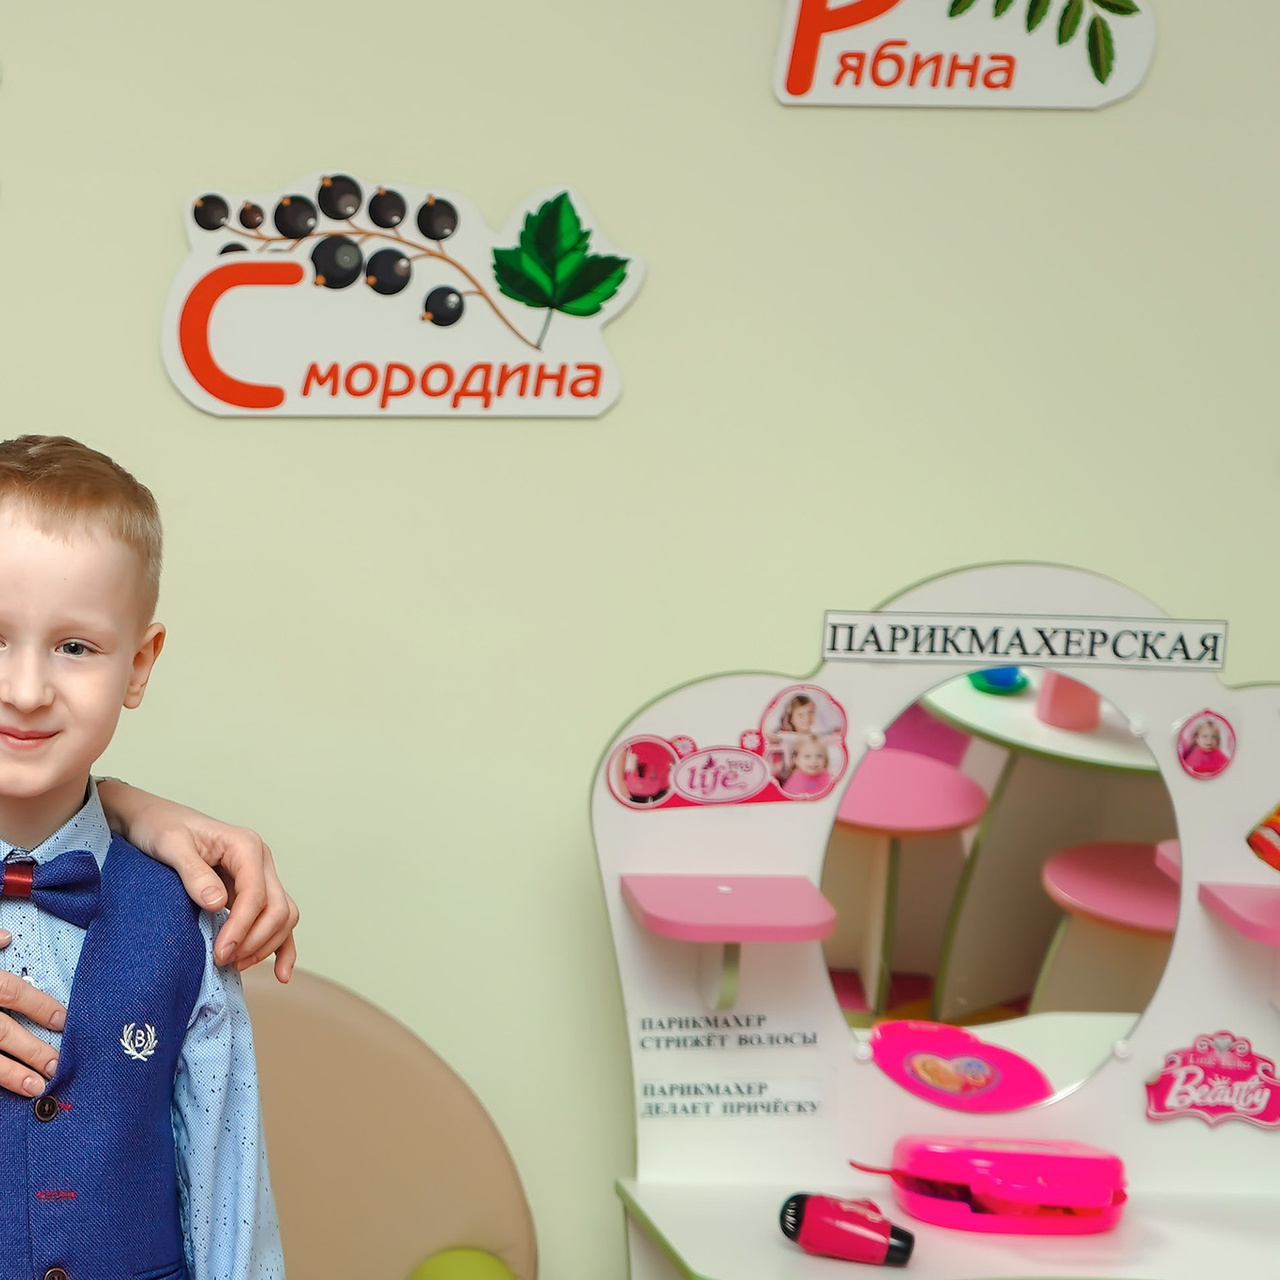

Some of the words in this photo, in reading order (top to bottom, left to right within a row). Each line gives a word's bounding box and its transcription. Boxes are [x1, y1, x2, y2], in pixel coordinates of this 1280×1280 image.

[178, 261, 603, 409] Смородина
[825, 622, 1223, 663] ПАРИКМАХЕРСКАЯ
[640, 1014, 767, 1031] ПАРИКМАХЕР
[737, 1031, 818, 1048] ВОЛОСЫ
[642, 1082, 769, 1098] ПАРИКМАХЕР
[1165, 1065, 1271, 1114] Beauty
[640, 1101, 714, 1118] ДЕЛАЕТ
